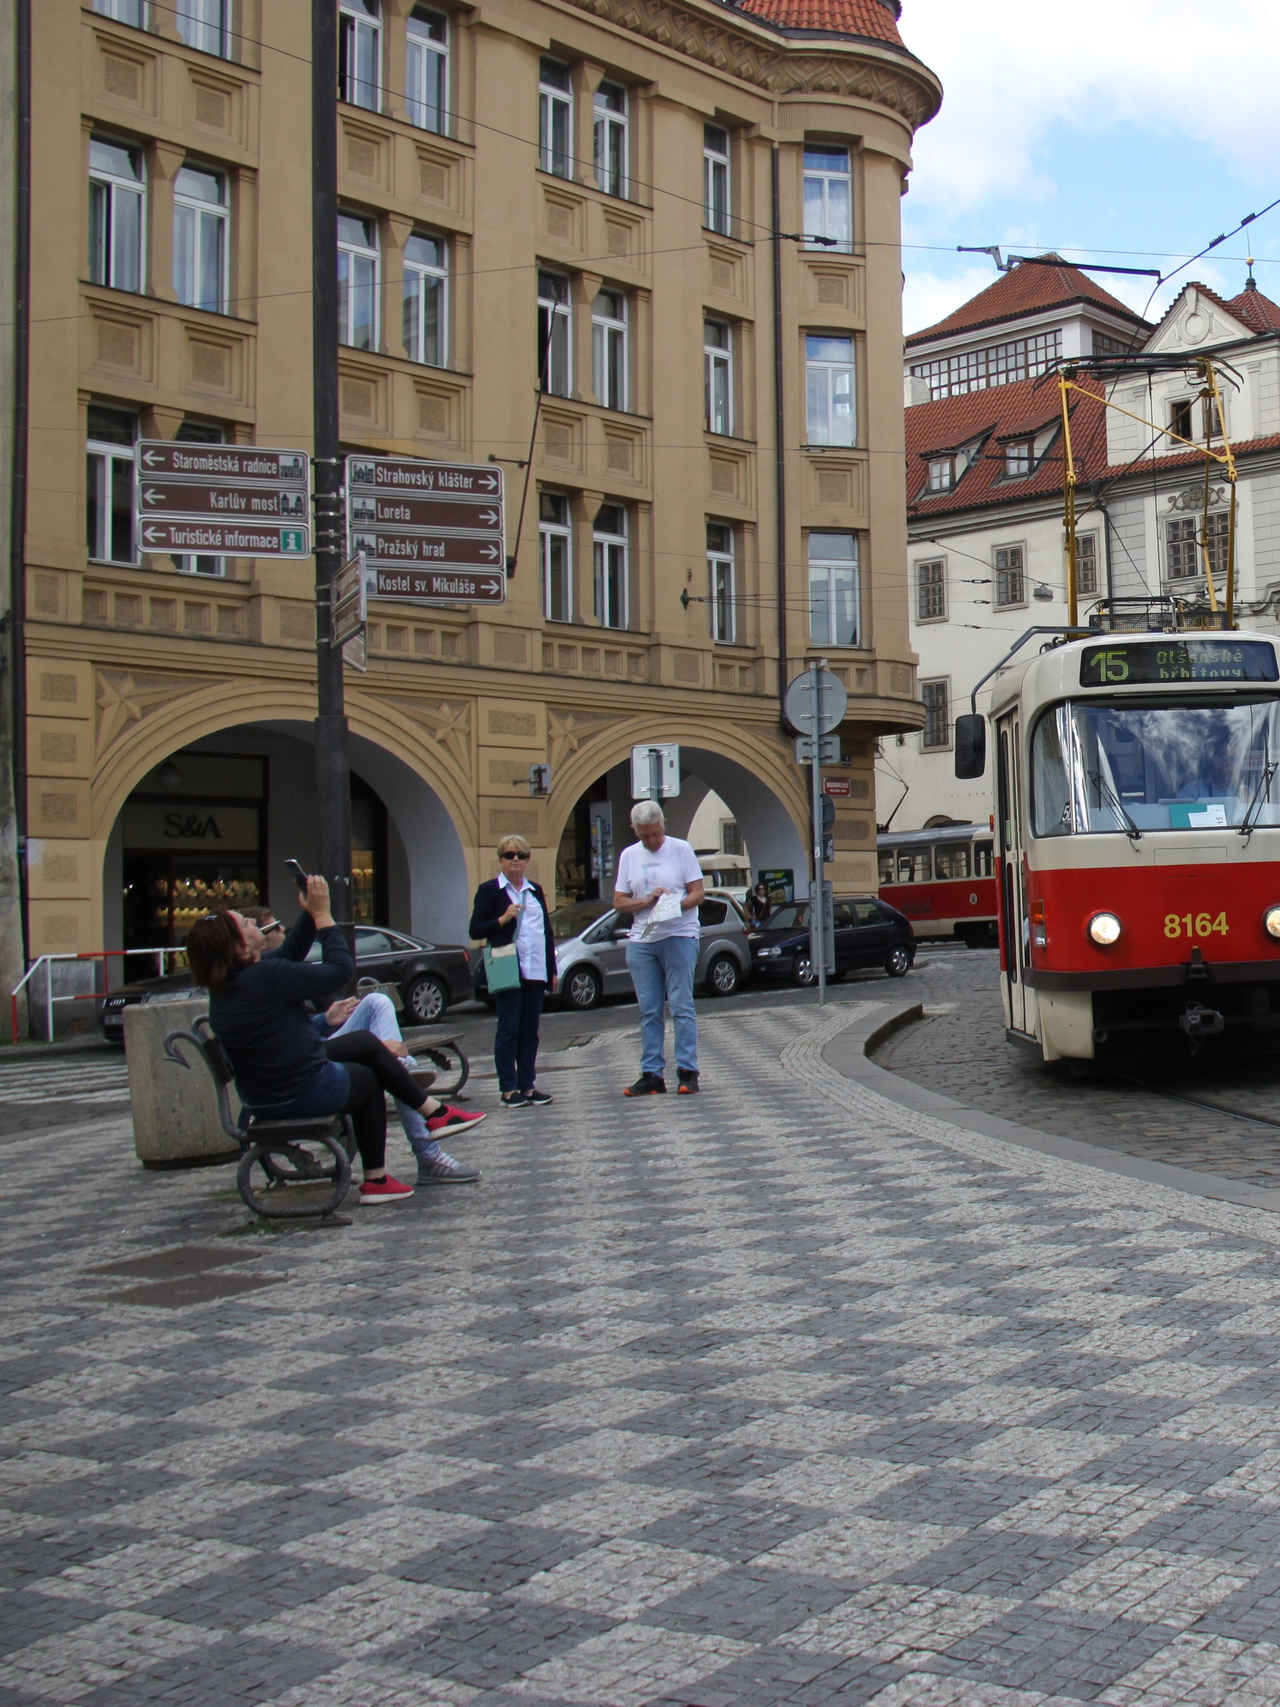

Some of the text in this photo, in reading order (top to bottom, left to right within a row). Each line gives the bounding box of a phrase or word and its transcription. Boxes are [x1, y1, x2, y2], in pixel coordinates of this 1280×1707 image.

[173, 452, 278, 475] Staroměstská radnice
[376, 467, 474, 490] Strahovský klášter
[210, 491, 279, 512] Karlův most
[377, 503, 411, 520] Loreta
[169, 526, 279, 549] Turistické informace
[378, 538, 445, 560] Pražský hrad
[379, 575, 411, 592] Kostel
[414, 579, 428, 593] sv.
[432, 576, 476, 595] Mikuláše
[1090, 650, 1129, 682] 15
[163, 812, 222, 839] S&A
[1163, 911, 1229, 939] 8164
